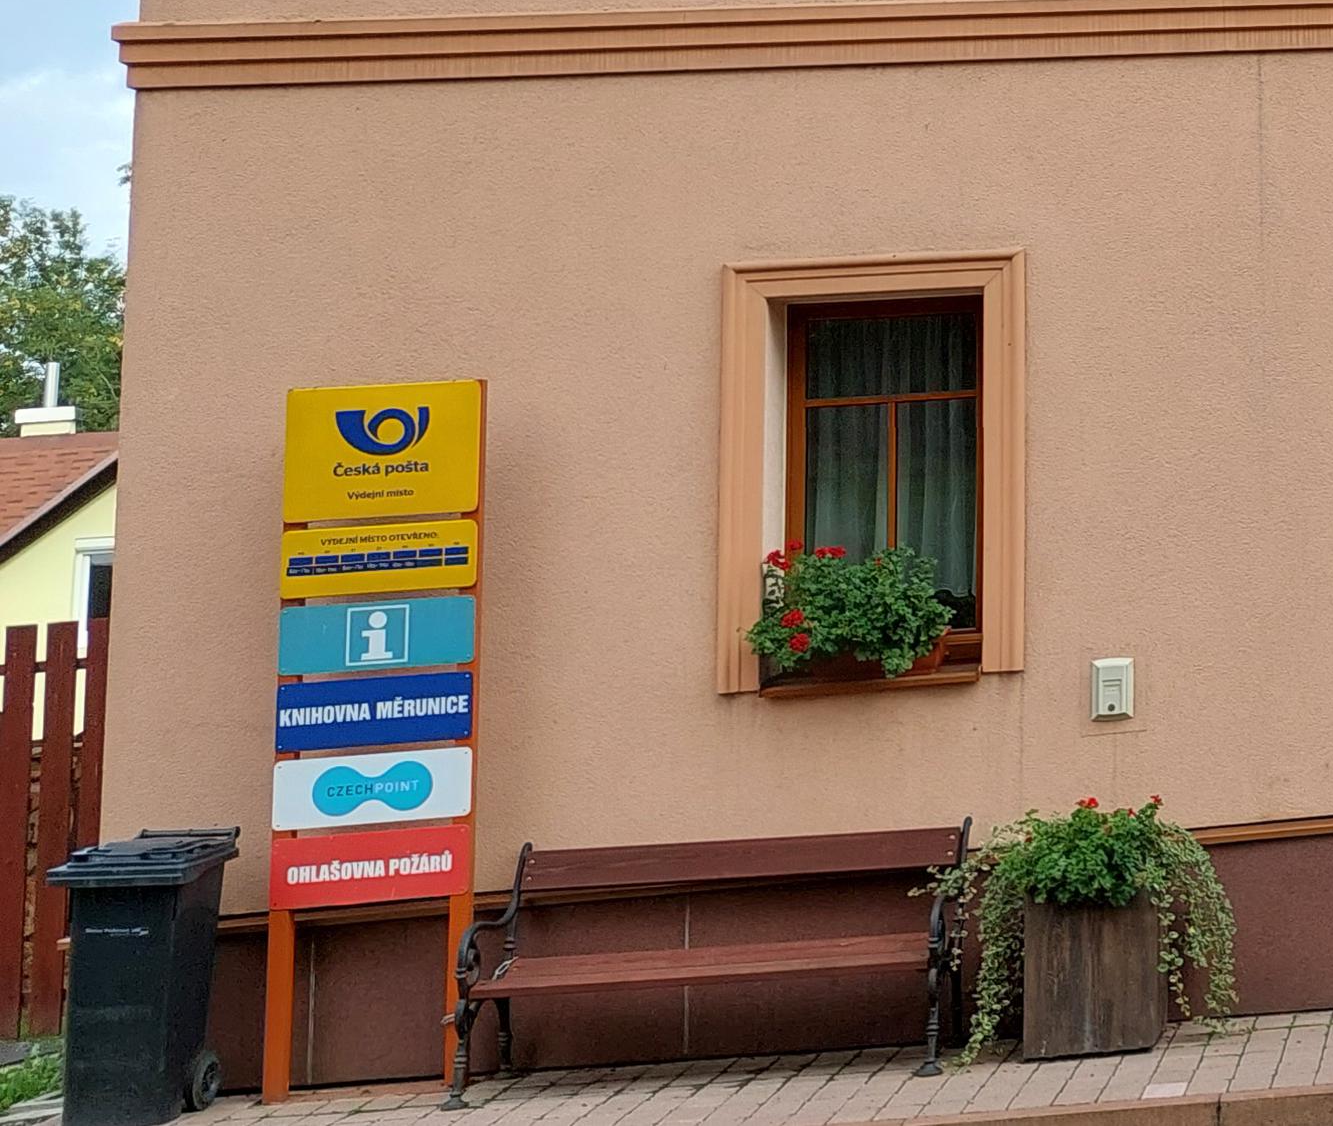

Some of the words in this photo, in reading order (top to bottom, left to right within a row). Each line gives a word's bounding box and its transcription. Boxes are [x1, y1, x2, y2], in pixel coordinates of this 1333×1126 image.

[333, 462, 380, 477] Česká
[385, 460, 429, 477] pošta
[279, 703, 371, 727] KNIHOVNA
[376, 695, 470, 720] MĚRUNICE
[287, 858, 385, 885] OHLAŠOVNA
[388, 850, 452, 876] POŽÁRŮ
